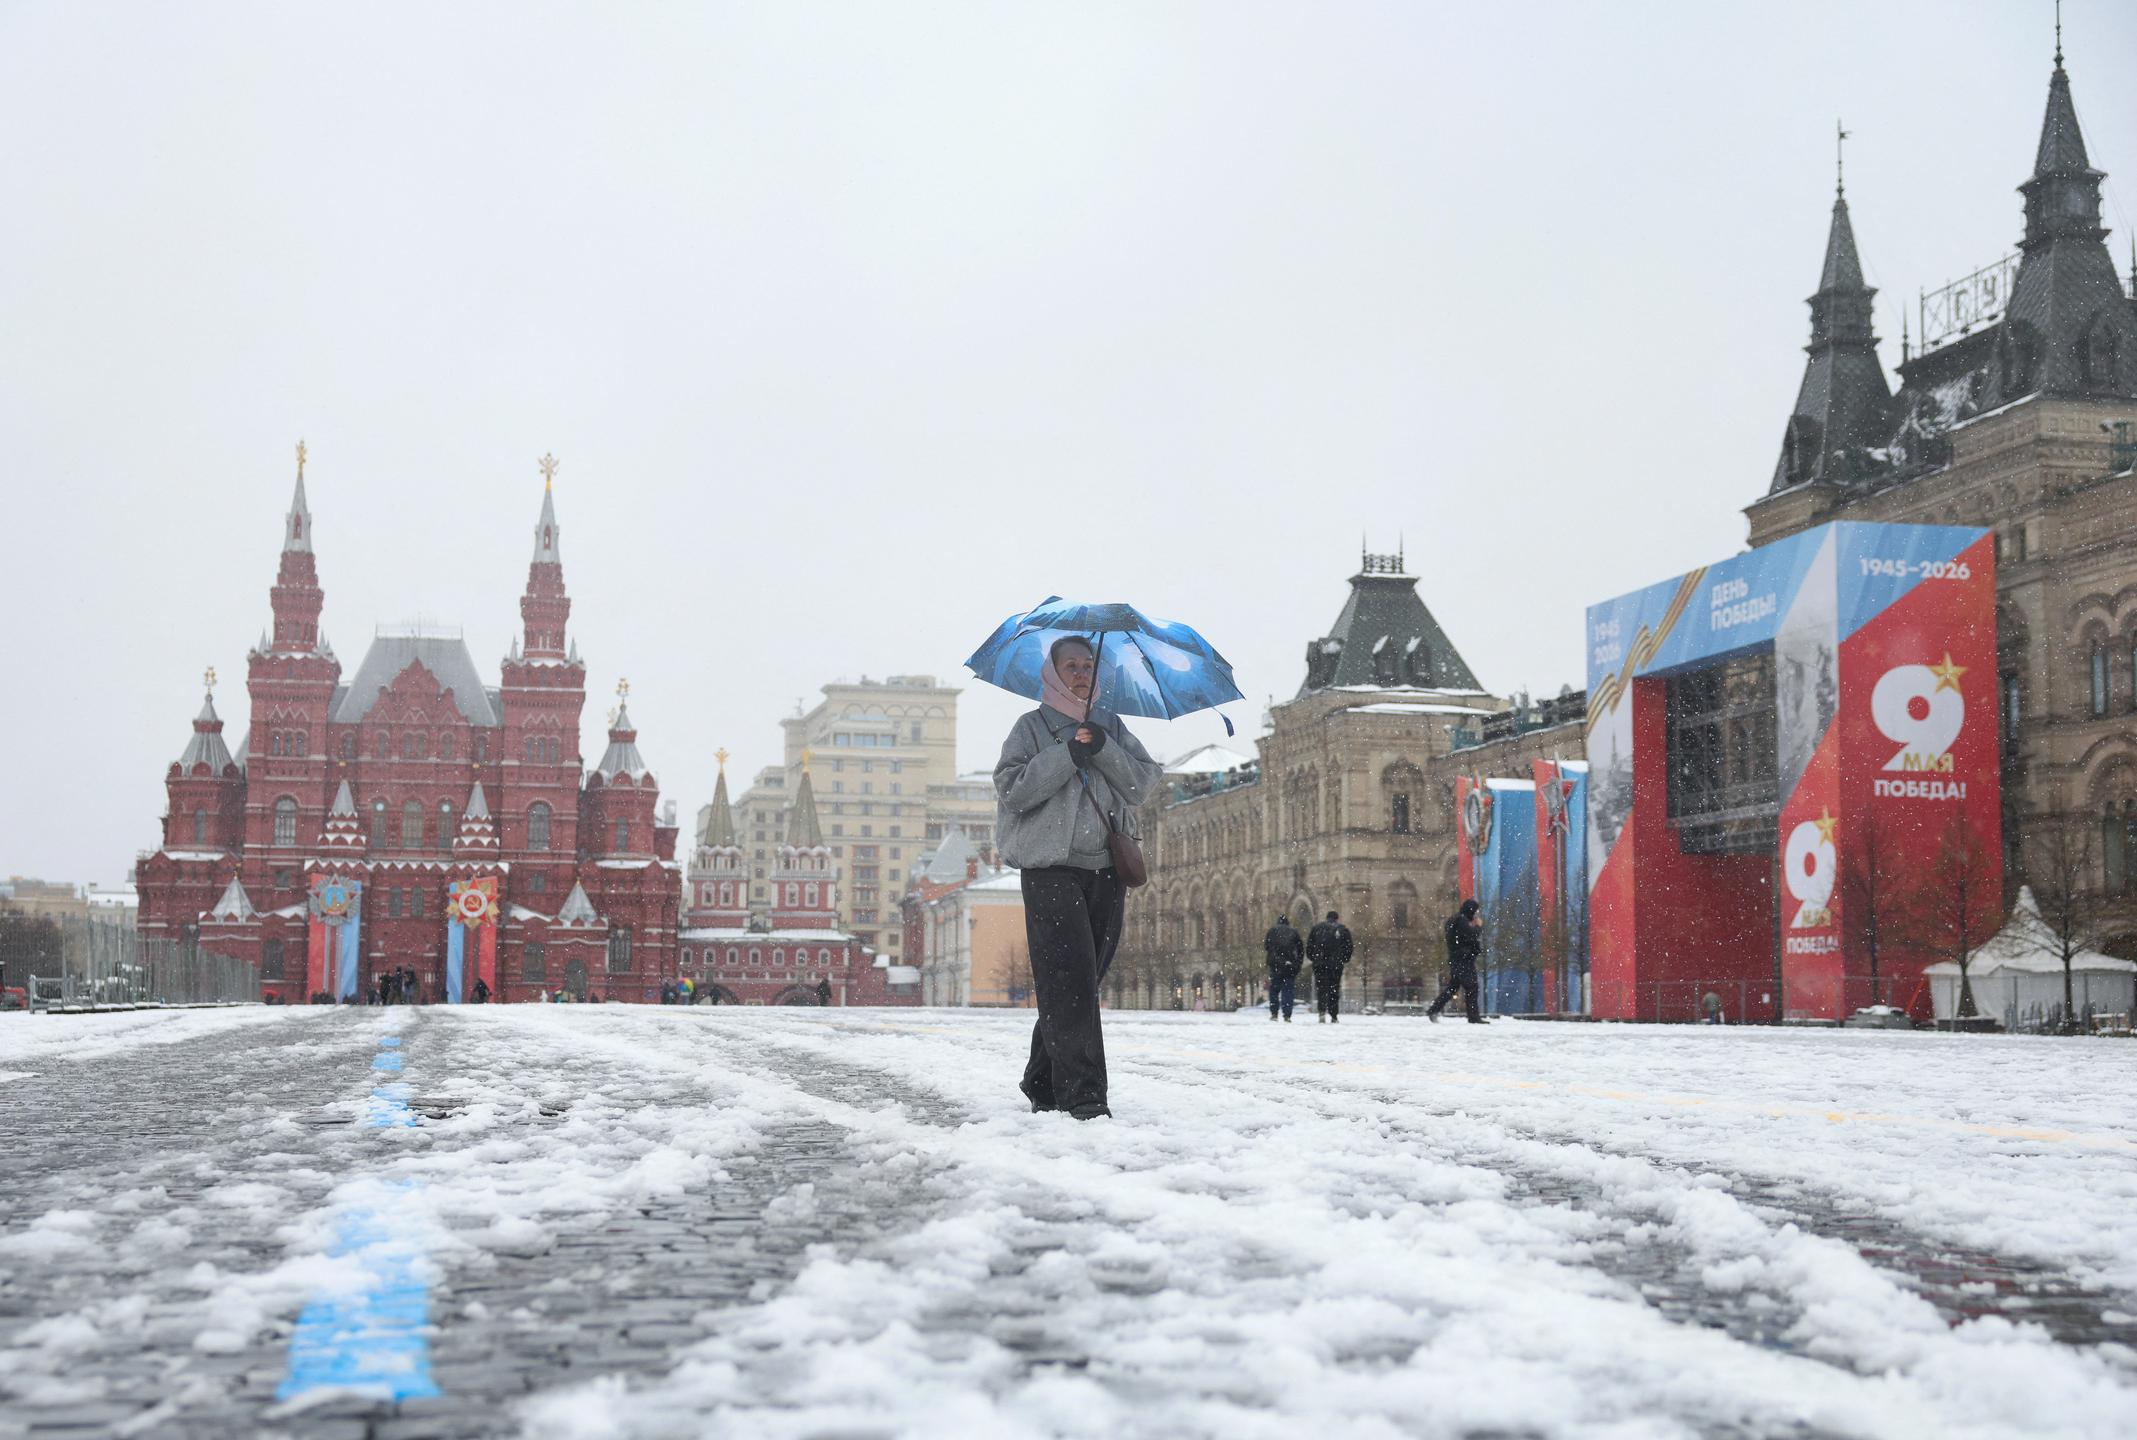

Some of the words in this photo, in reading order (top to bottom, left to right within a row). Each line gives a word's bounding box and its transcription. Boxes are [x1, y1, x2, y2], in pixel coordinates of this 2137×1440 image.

[1711, 576, 1749, 609] ДЕНЬ
[1711, 592, 1777, 631] ПОБЕДЫ!
[1871, 664, 1965, 771] 9
[1903, 752, 1954, 773] МАЯ
[1873, 778, 1967, 800] ПОБЕДА!
[1785, 820, 1837, 928] 9
